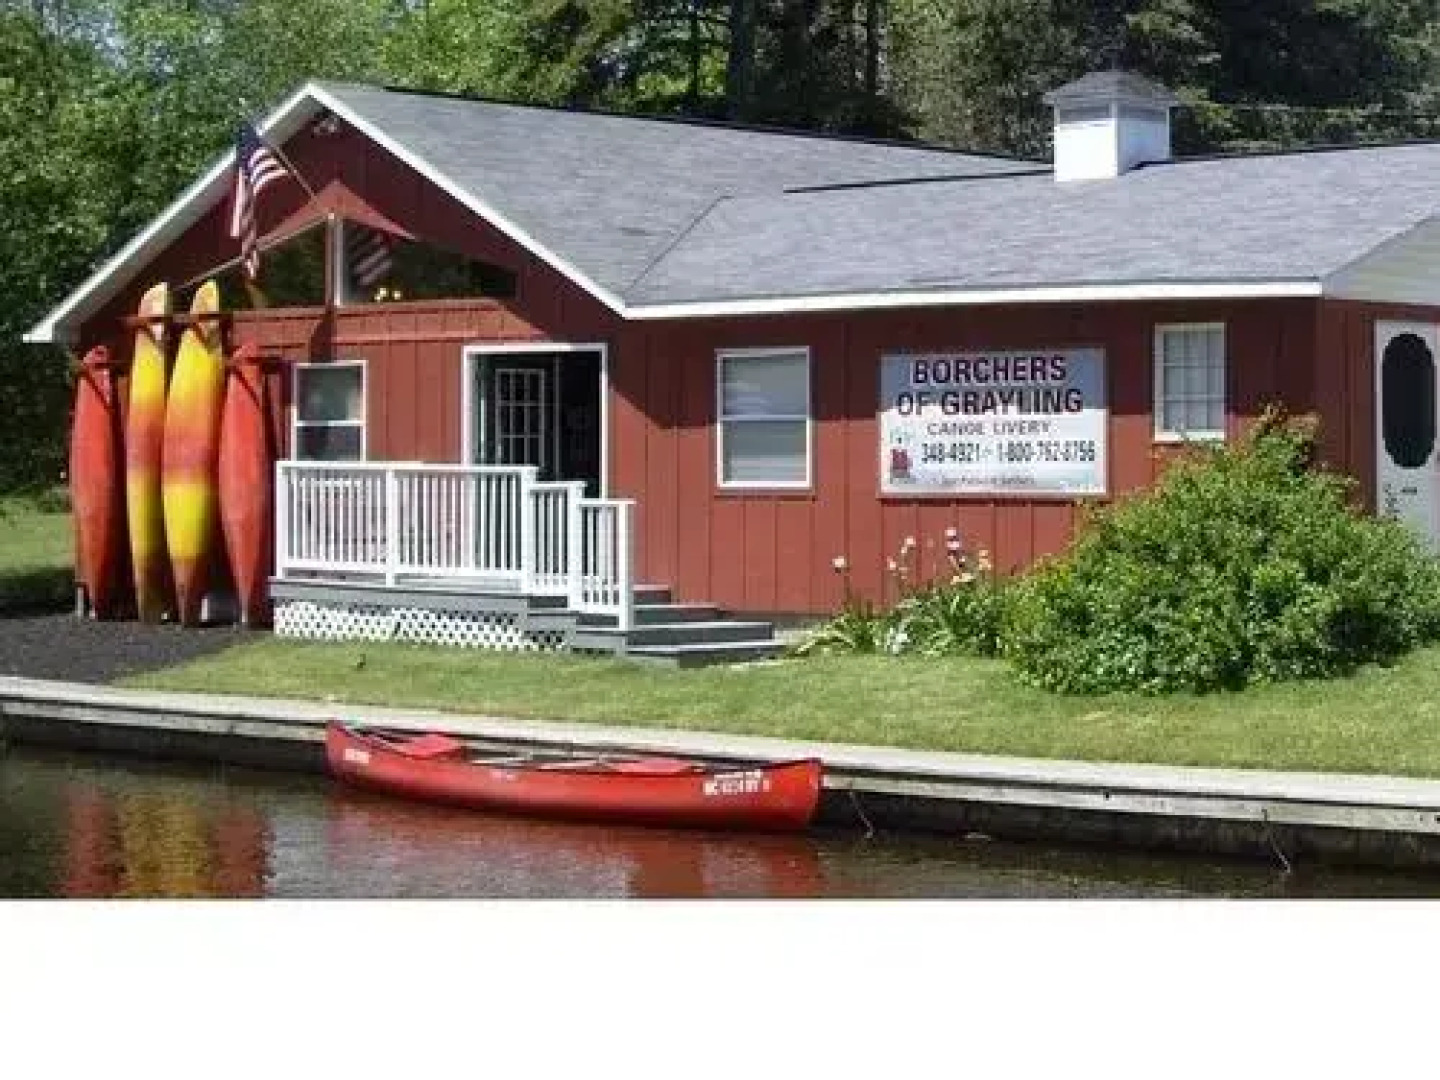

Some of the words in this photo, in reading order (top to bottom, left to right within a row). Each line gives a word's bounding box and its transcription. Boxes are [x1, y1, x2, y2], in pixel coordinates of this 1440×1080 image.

[912, 355, 1067, 384] BORCHERS
[898, 390, 931, 416] OF
[941, 388, 1084, 416] GRAYLING
[926, 421, 984, 436] CANOE
[993, 419, 1051, 436] LIVERY
